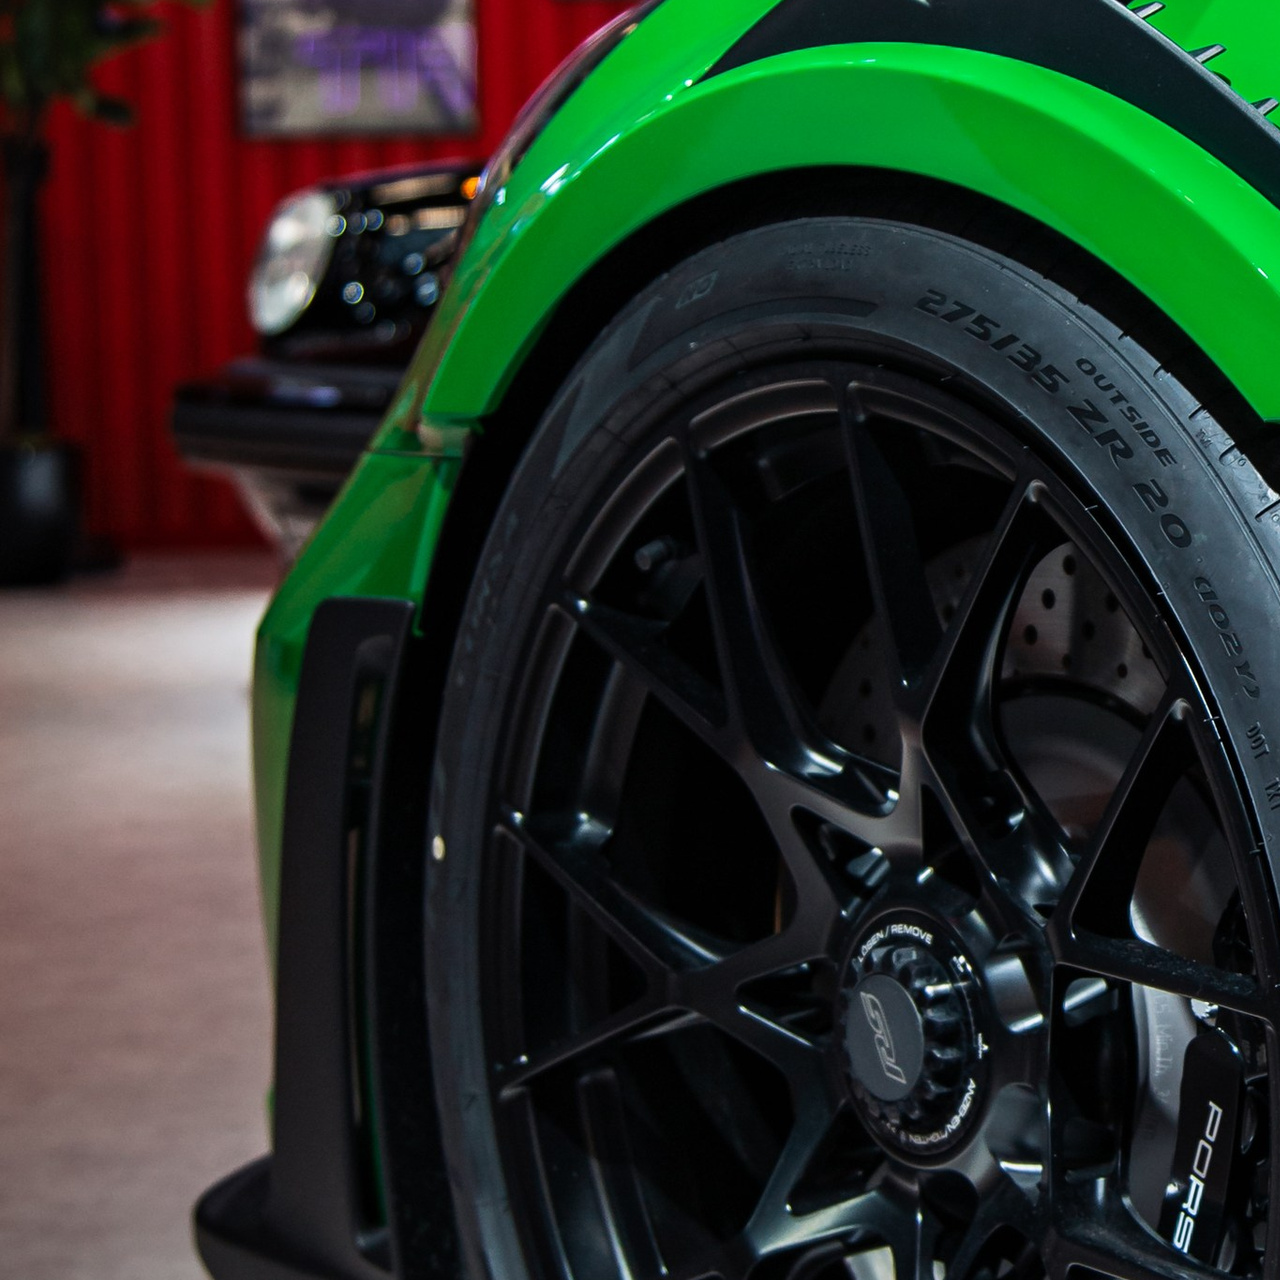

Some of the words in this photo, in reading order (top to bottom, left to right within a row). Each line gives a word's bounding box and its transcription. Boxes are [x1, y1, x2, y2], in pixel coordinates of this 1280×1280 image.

[1075, 357, 1177, 468] OUTSIDE
[914, 289, 1070, 395] 275/35
[1065, 398, 1134, 470] ZR
[1132, 478, 1193, 548] 20
[1194, 575, 1261, 700] (102Y)
[1245, 722, 1271, 761] DOT
[890, 924, 933, 945] REMOVE
